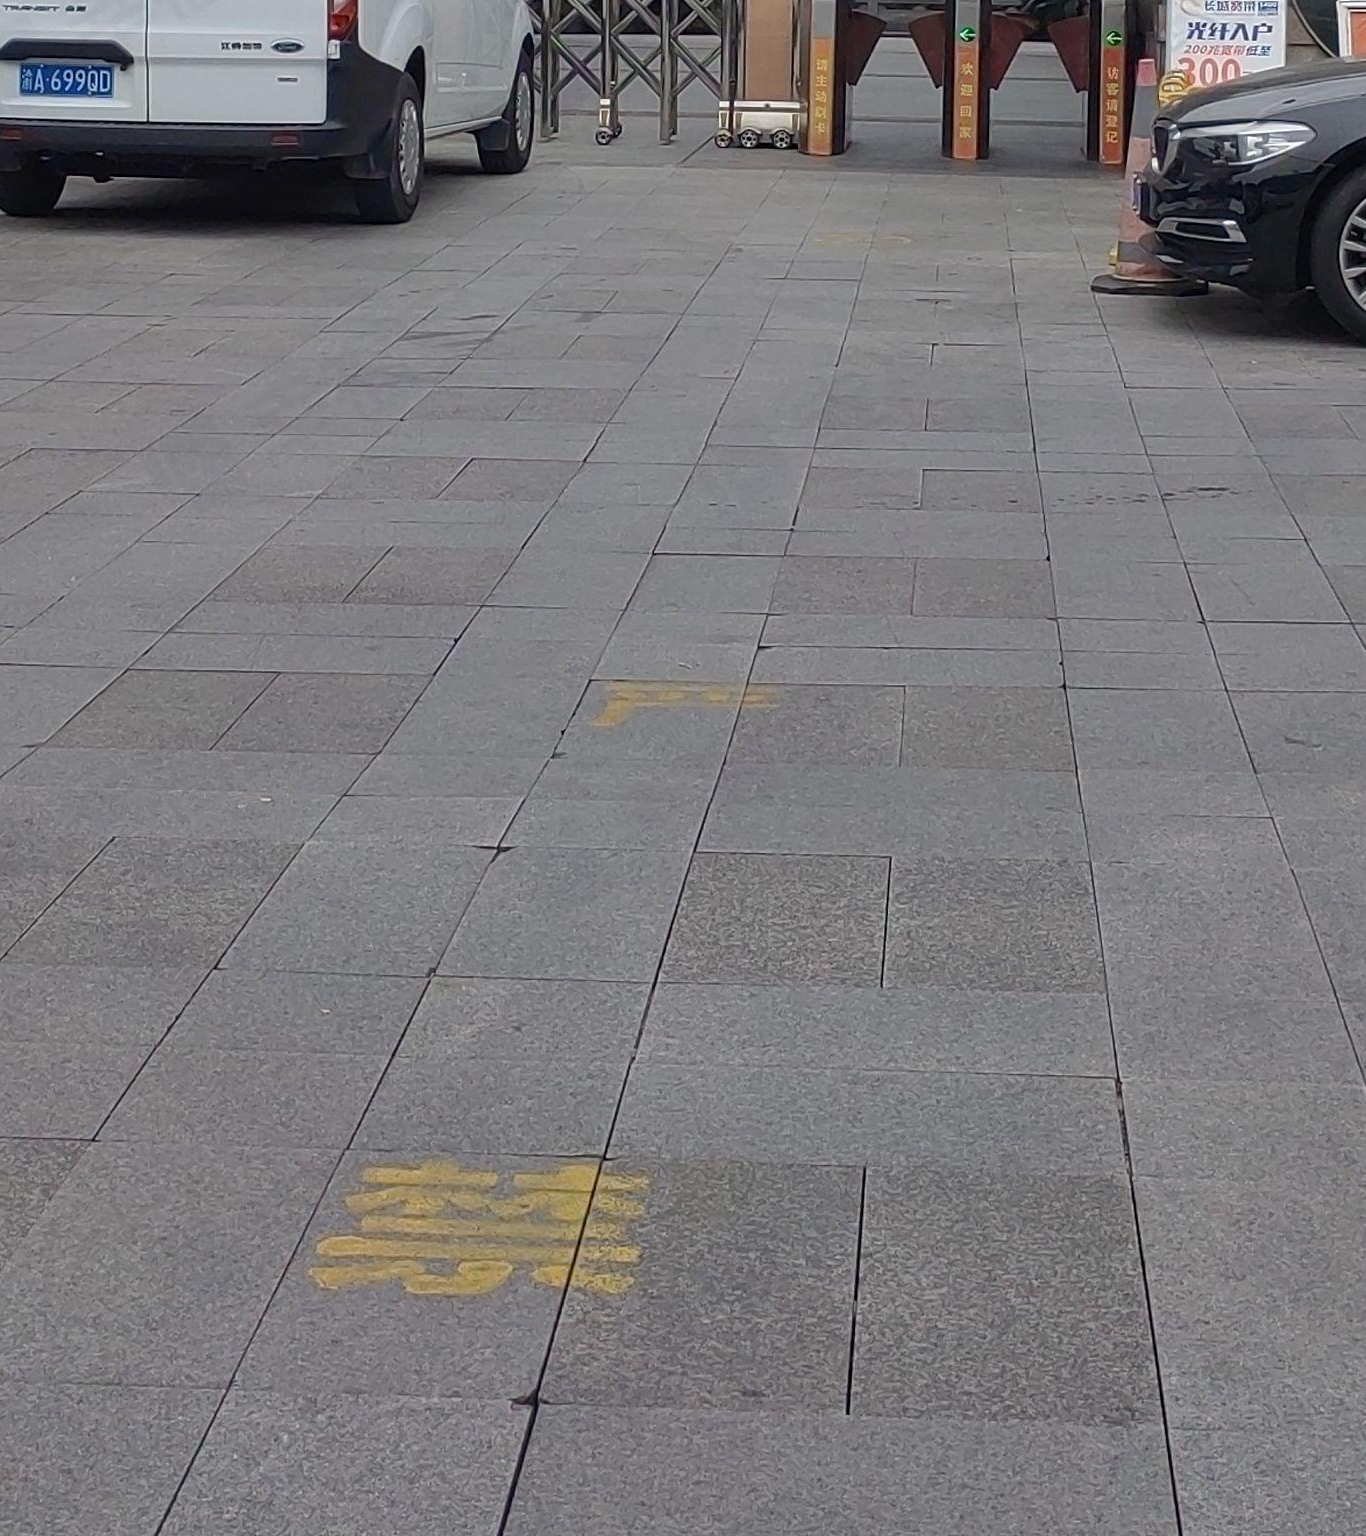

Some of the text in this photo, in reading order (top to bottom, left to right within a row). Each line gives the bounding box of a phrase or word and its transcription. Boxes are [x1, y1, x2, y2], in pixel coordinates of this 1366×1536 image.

[1186, 22, 1274, 42] 光纤入户
[959, 62, 974, 140] 欢迎回家
